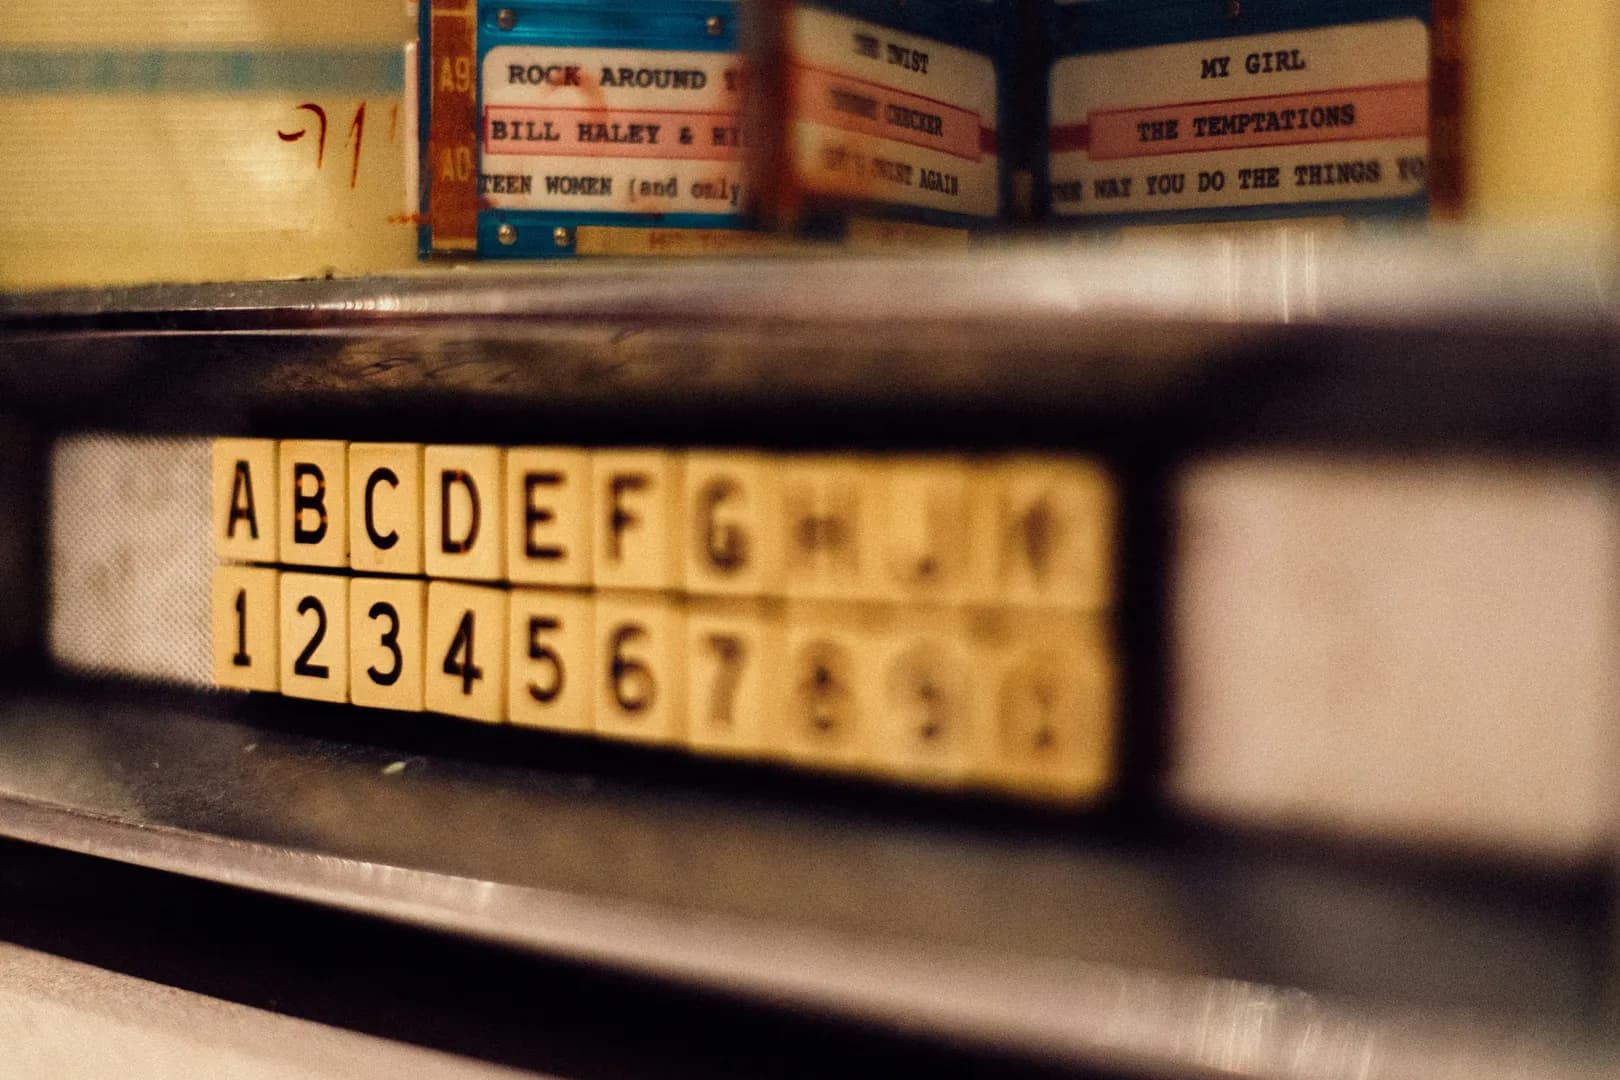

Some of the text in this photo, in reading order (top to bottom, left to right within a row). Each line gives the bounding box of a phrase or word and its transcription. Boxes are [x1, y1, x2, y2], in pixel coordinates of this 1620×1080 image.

[438, 56, 472, 93] A9
[508, 64, 582, 87] ROCK
[600, 68, 707, 91] AROUND
[1200, 49, 1306, 79] MY GIRL
[491, 120, 560, 142] BILL
[577, 123, 662, 145] HALEY
[679, 127, 693, 145] &
[1136, 103, 1356, 143] THE TEMPTATIONS
[545, 176, 612, 197] WOMEN
[629, 177, 678, 201] (and
[918, 167, 959, 197] AGAIN
[1147, 173, 1185, 195] YOU
[1199, 171, 1225, 193] DO
[1238, 167, 1280, 190] THE
[1295, 160, 1382, 186] THINGS
[226, 459, 259, 540] A
[293, 462, 329, 545] B
[364, 466, 400, 550] C
[440, 469, 482, 554] D
[524, 470, 567, 560] E
[609, 471, 654, 562] F
[232, 587, 252, 667] 1
[294, 595, 330, 679] 2
[366, 601, 403, 686] 3
[443, 608, 483, 696] 4
[526, 615, 566, 703] 5
[610, 621, 658, 713] 6
